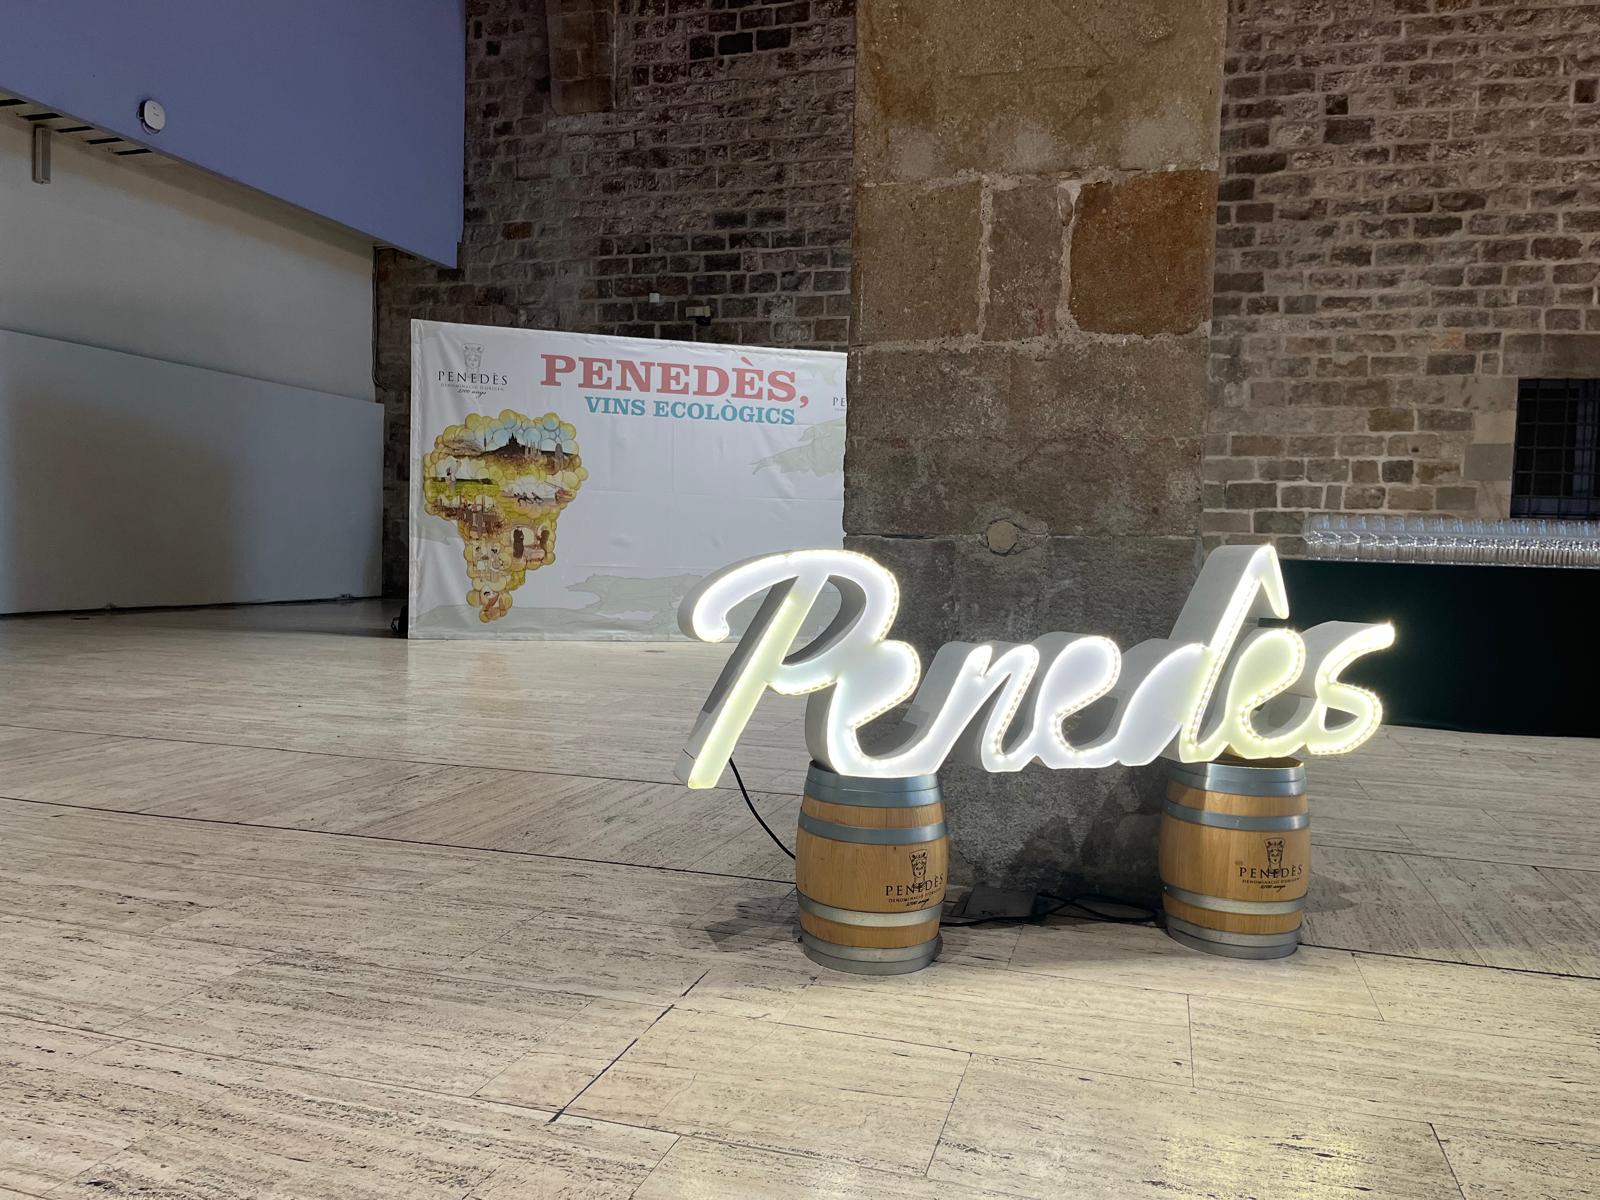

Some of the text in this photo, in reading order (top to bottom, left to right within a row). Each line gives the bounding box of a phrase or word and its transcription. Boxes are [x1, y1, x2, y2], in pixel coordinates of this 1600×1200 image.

[438, 371, 508, 386] PENEDÈS
[540, 354, 809, 408] PENEDÈS,
[584, 396, 795, 425] VINS ECOLÒGICS
[1239, 864, 1303, 879] PENEDÈS
[885, 872, 944, 896] PENEDÈS
